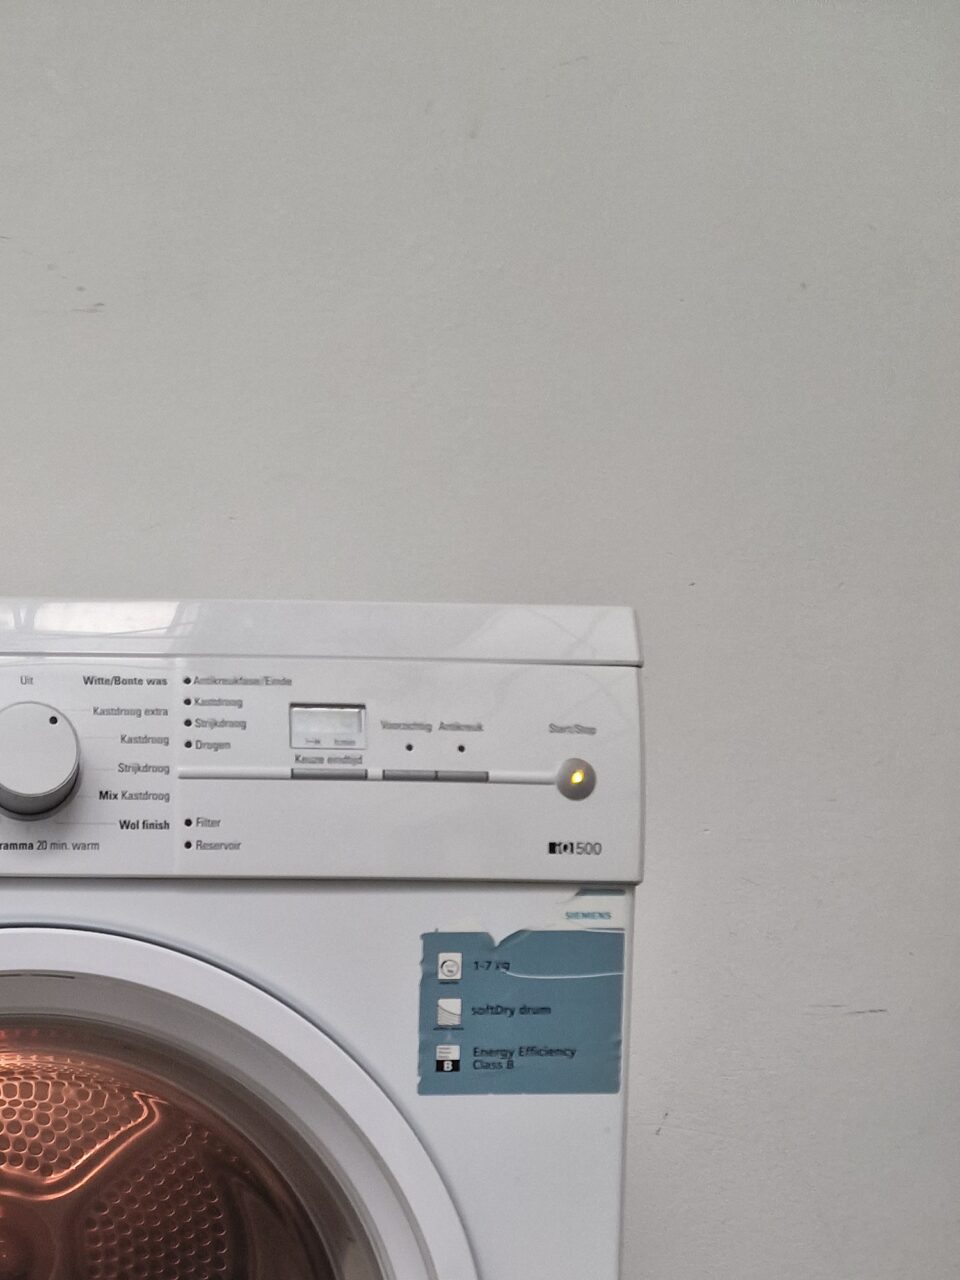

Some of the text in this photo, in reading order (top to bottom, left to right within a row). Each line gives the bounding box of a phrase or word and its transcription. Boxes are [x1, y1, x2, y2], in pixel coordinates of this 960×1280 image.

[19, 675, 34, 685] Uit
[82, 675, 168, 686] Witte/Bonte was
[92, 706, 169, 718] Kastdroog extra
[194, 718, 247, 730] Strijkdroog
[120, 735, 170, 746] Kastdroog
[195, 740, 231, 752] Drogen
[117, 763, 170, 775] Strijkdroog
[98, 790, 171, 803] Mix Kastdroog
[118, 819, 170, 831] Wol finish
[196, 817, 221, 828] Filter
[36, 840, 48, 851] 20
[49, 841, 71, 851] min.
[72, 843, 100, 851] warm
[196, 840, 242, 851] Reservoir
[564, 911, 612, 920] SIEMENS
[518, 1004, 552, 1015] drum
[473, 1047, 577, 1060] Energy Efficiency
[472, 1060, 503, 1071] Class
